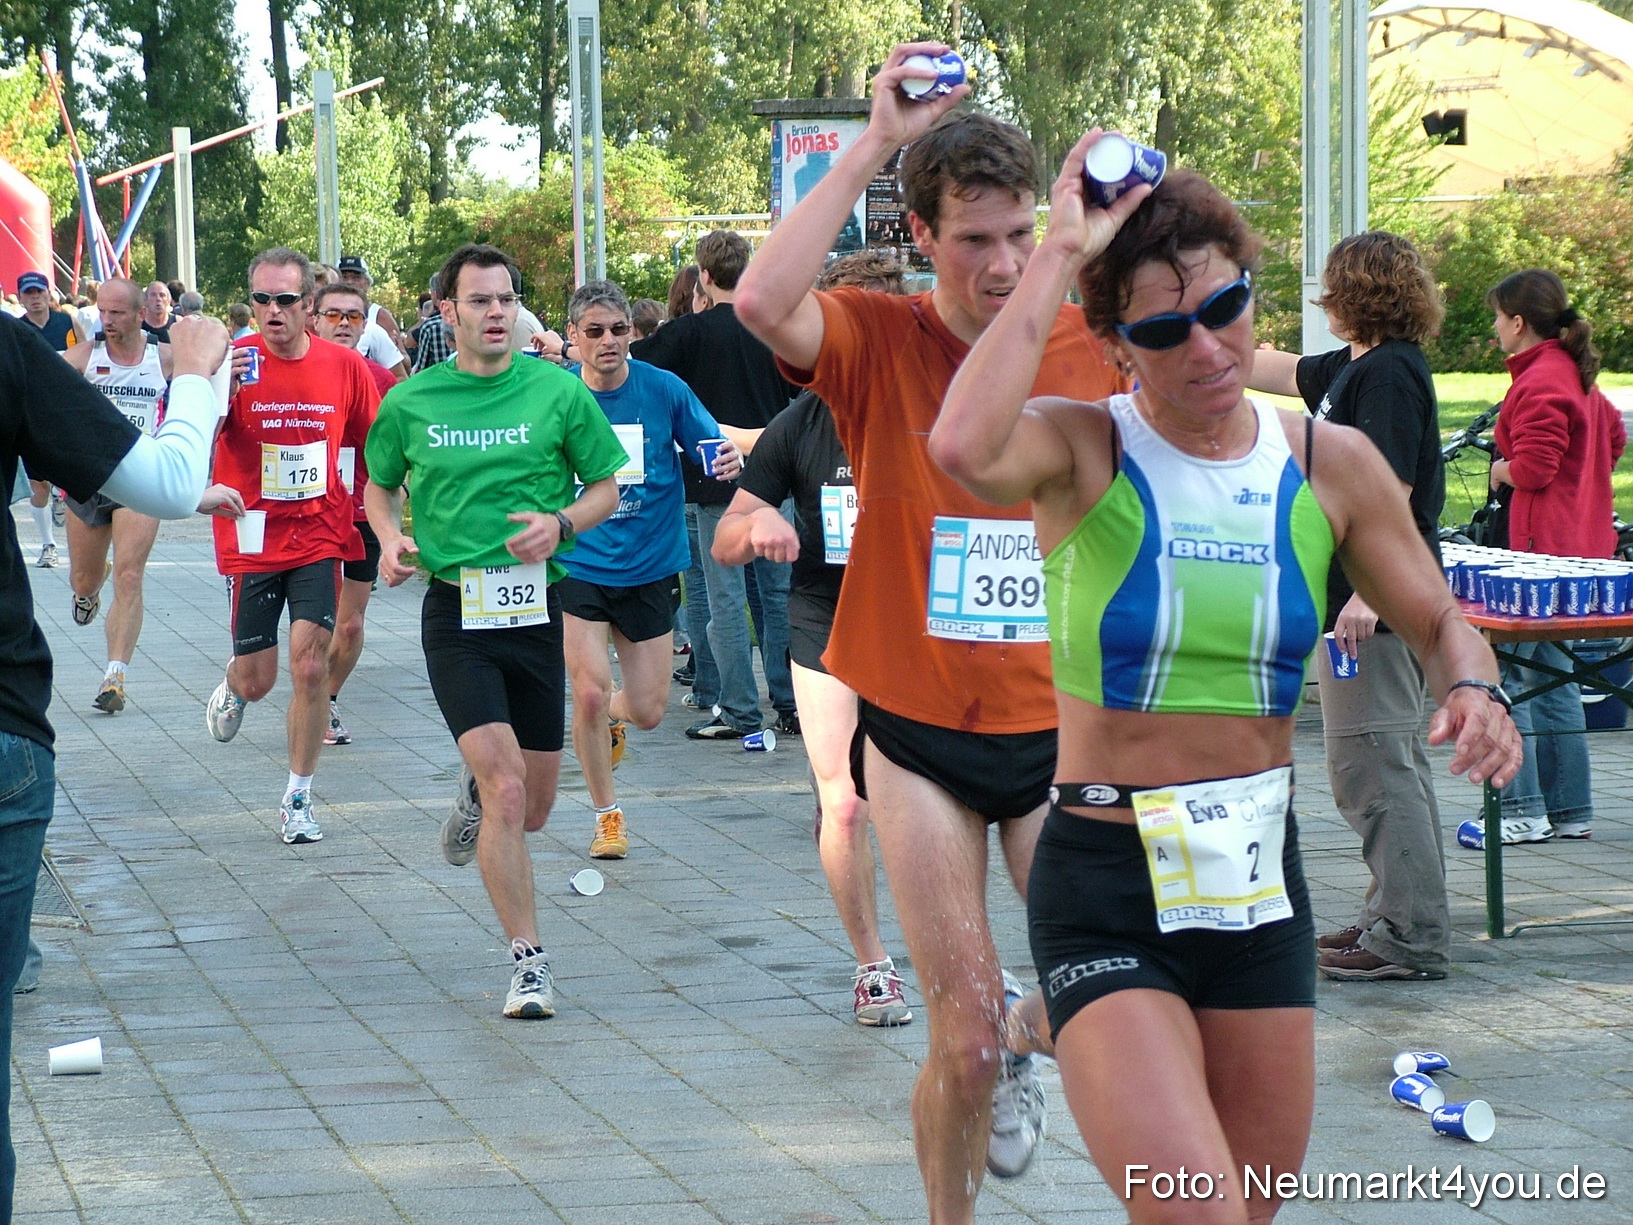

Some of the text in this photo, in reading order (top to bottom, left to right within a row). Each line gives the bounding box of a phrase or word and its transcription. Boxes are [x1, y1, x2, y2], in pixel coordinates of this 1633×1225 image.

[791, 124, 820, 137] Bruno
[785, 130, 840, 164] Jonas
[116, 399, 148, 410] Hermann
[251, 401, 336, 414] Überlegen bewegen.
[126, 415, 146, 428] 50
[262, 418, 283, 429] VAG
[427, 422, 531, 452] Sinupret
[280, 450, 305, 462] Klaus
[288, 467, 319, 485] 178
[1168, 537, 1270, 566] BOCK
[465, 583, 535, 607] A 352
[973, 574, 1047, 608] 369
[929, 619, 984, 634] BOCK
[1186, 799, 1228, 824] Eva
[1157, 841, 1260, 883] A 2
[1160, 906, 1225, 924] BOCK
[1048, 956, 1140, 999] BOCK
